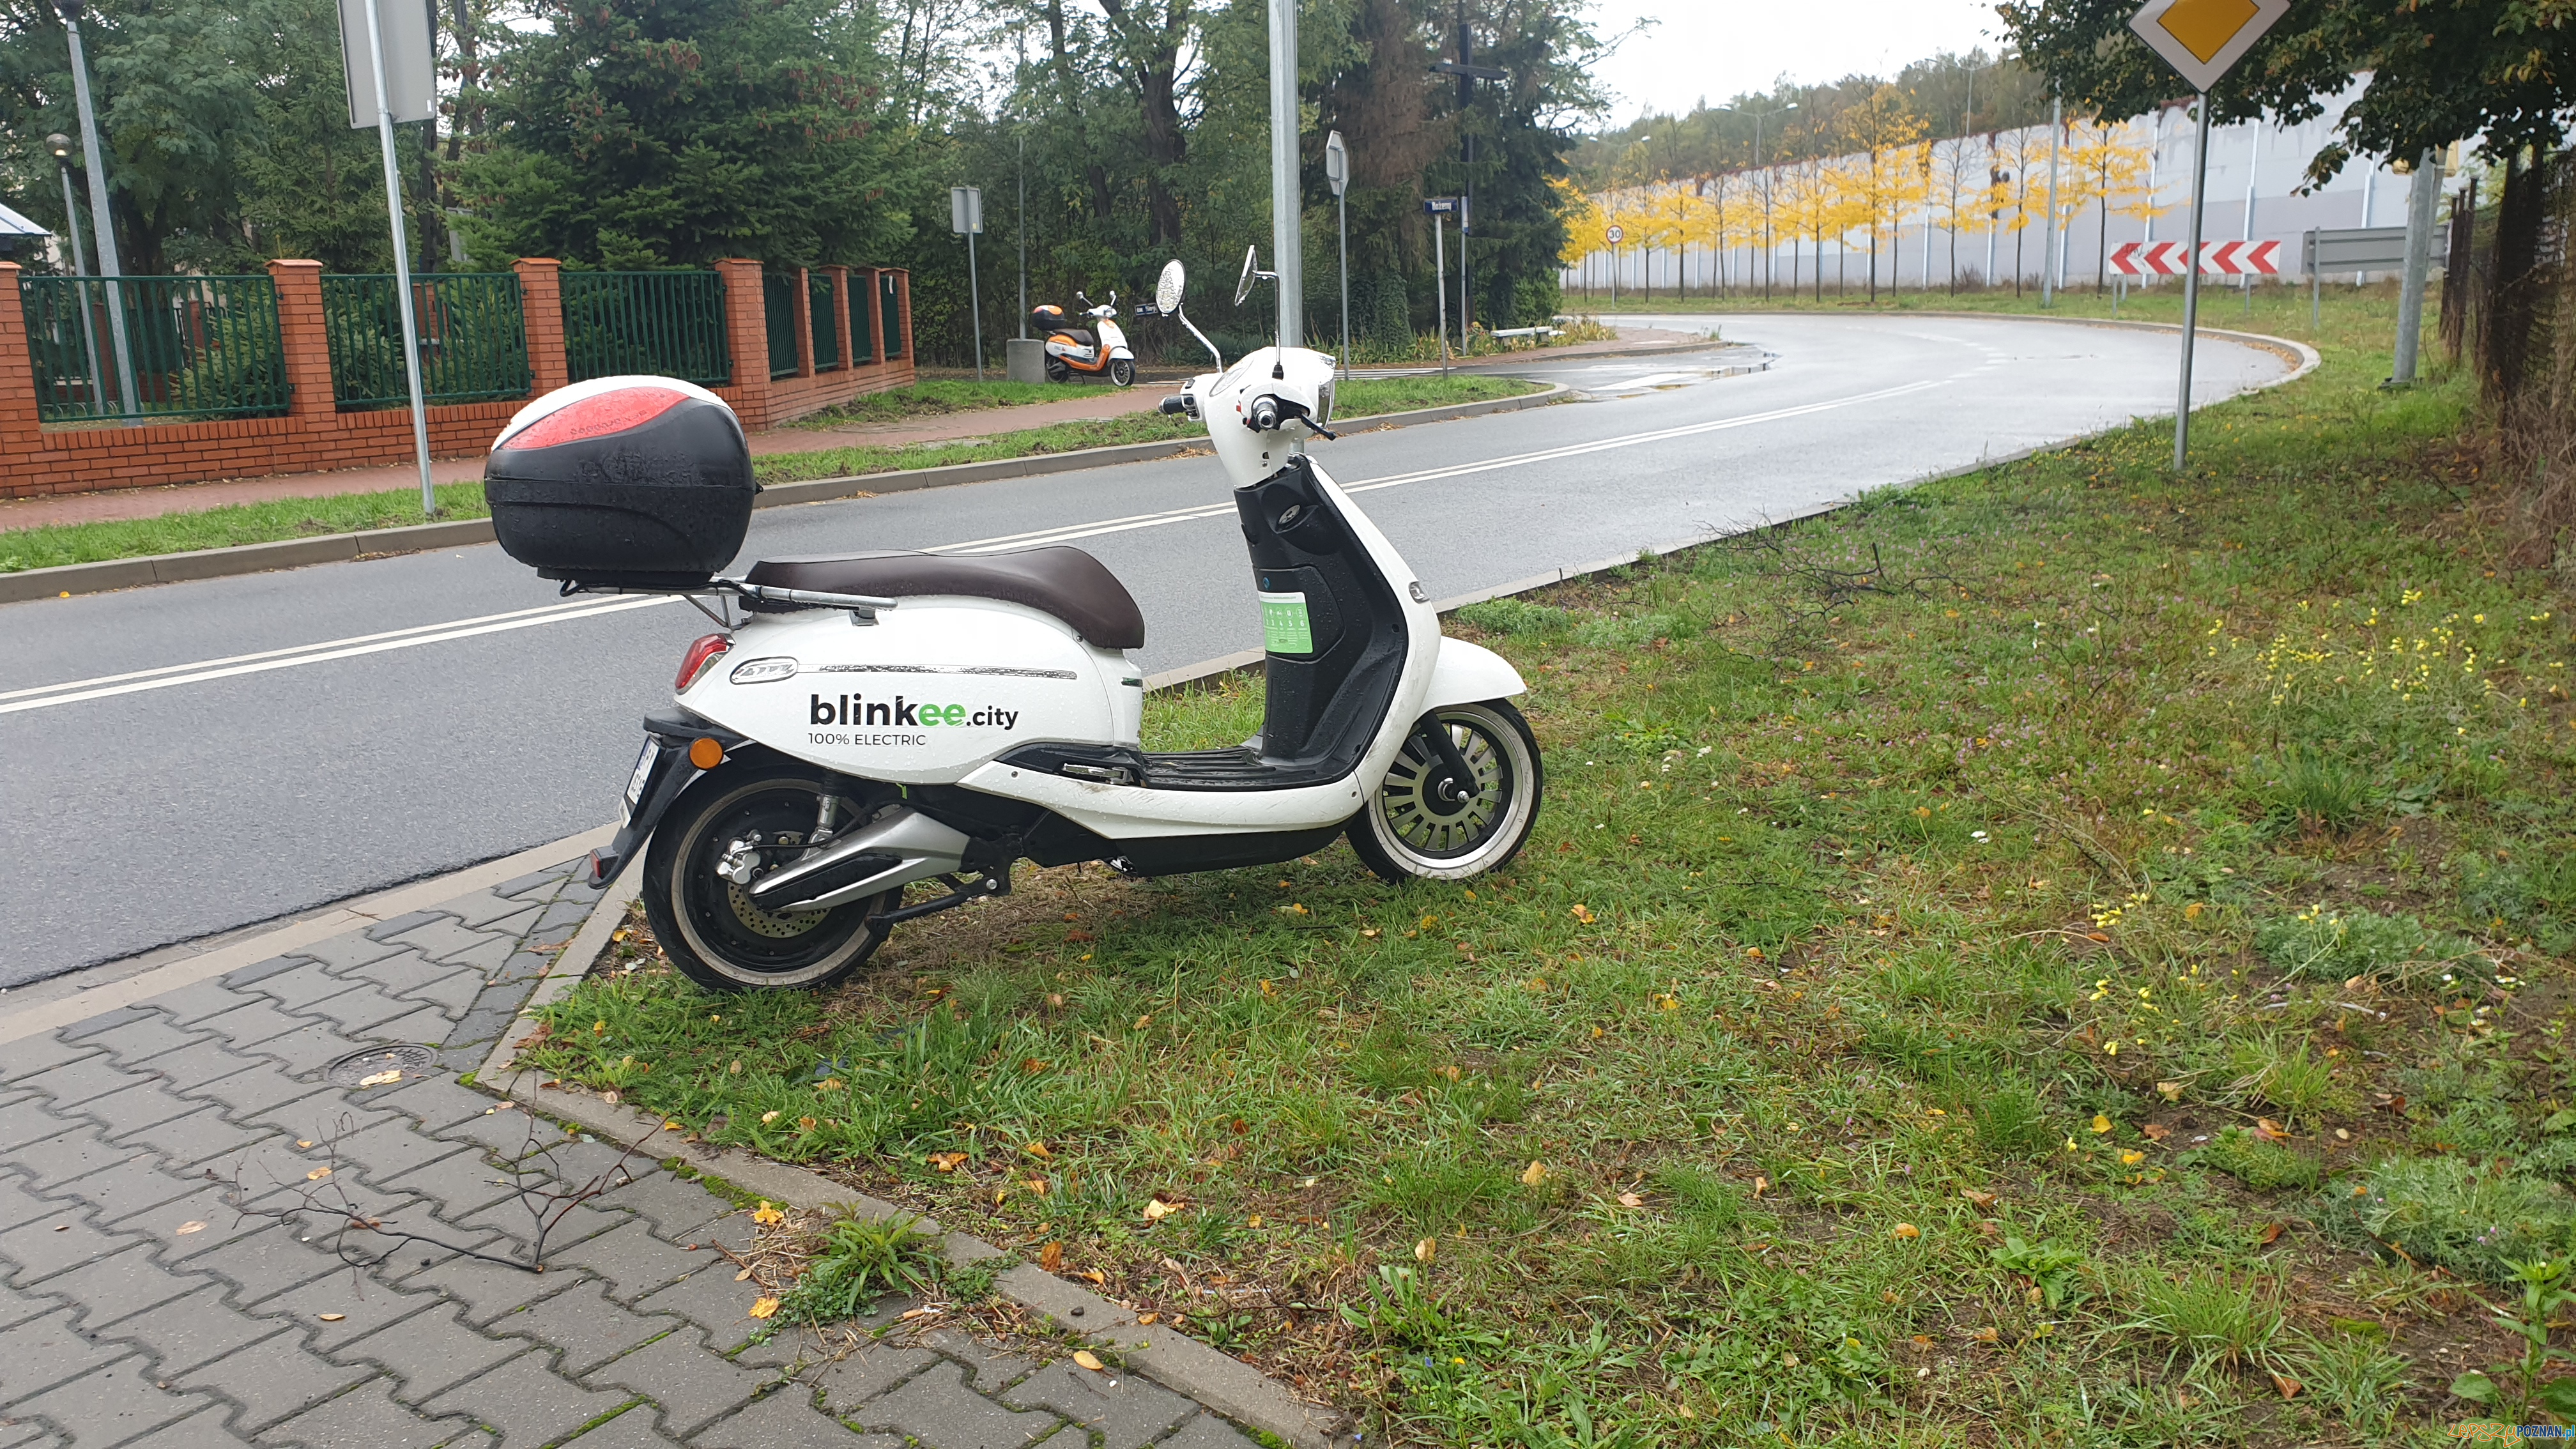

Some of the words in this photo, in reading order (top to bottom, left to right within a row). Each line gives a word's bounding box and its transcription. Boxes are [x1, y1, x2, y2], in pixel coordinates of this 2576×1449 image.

[1609, 230, 1621, 238] 30
[811, 693, 1019, 730] blinkee.city
[808, 733, 850, 745] 100%
[855, 734, 926, 746] ELECTRIC
